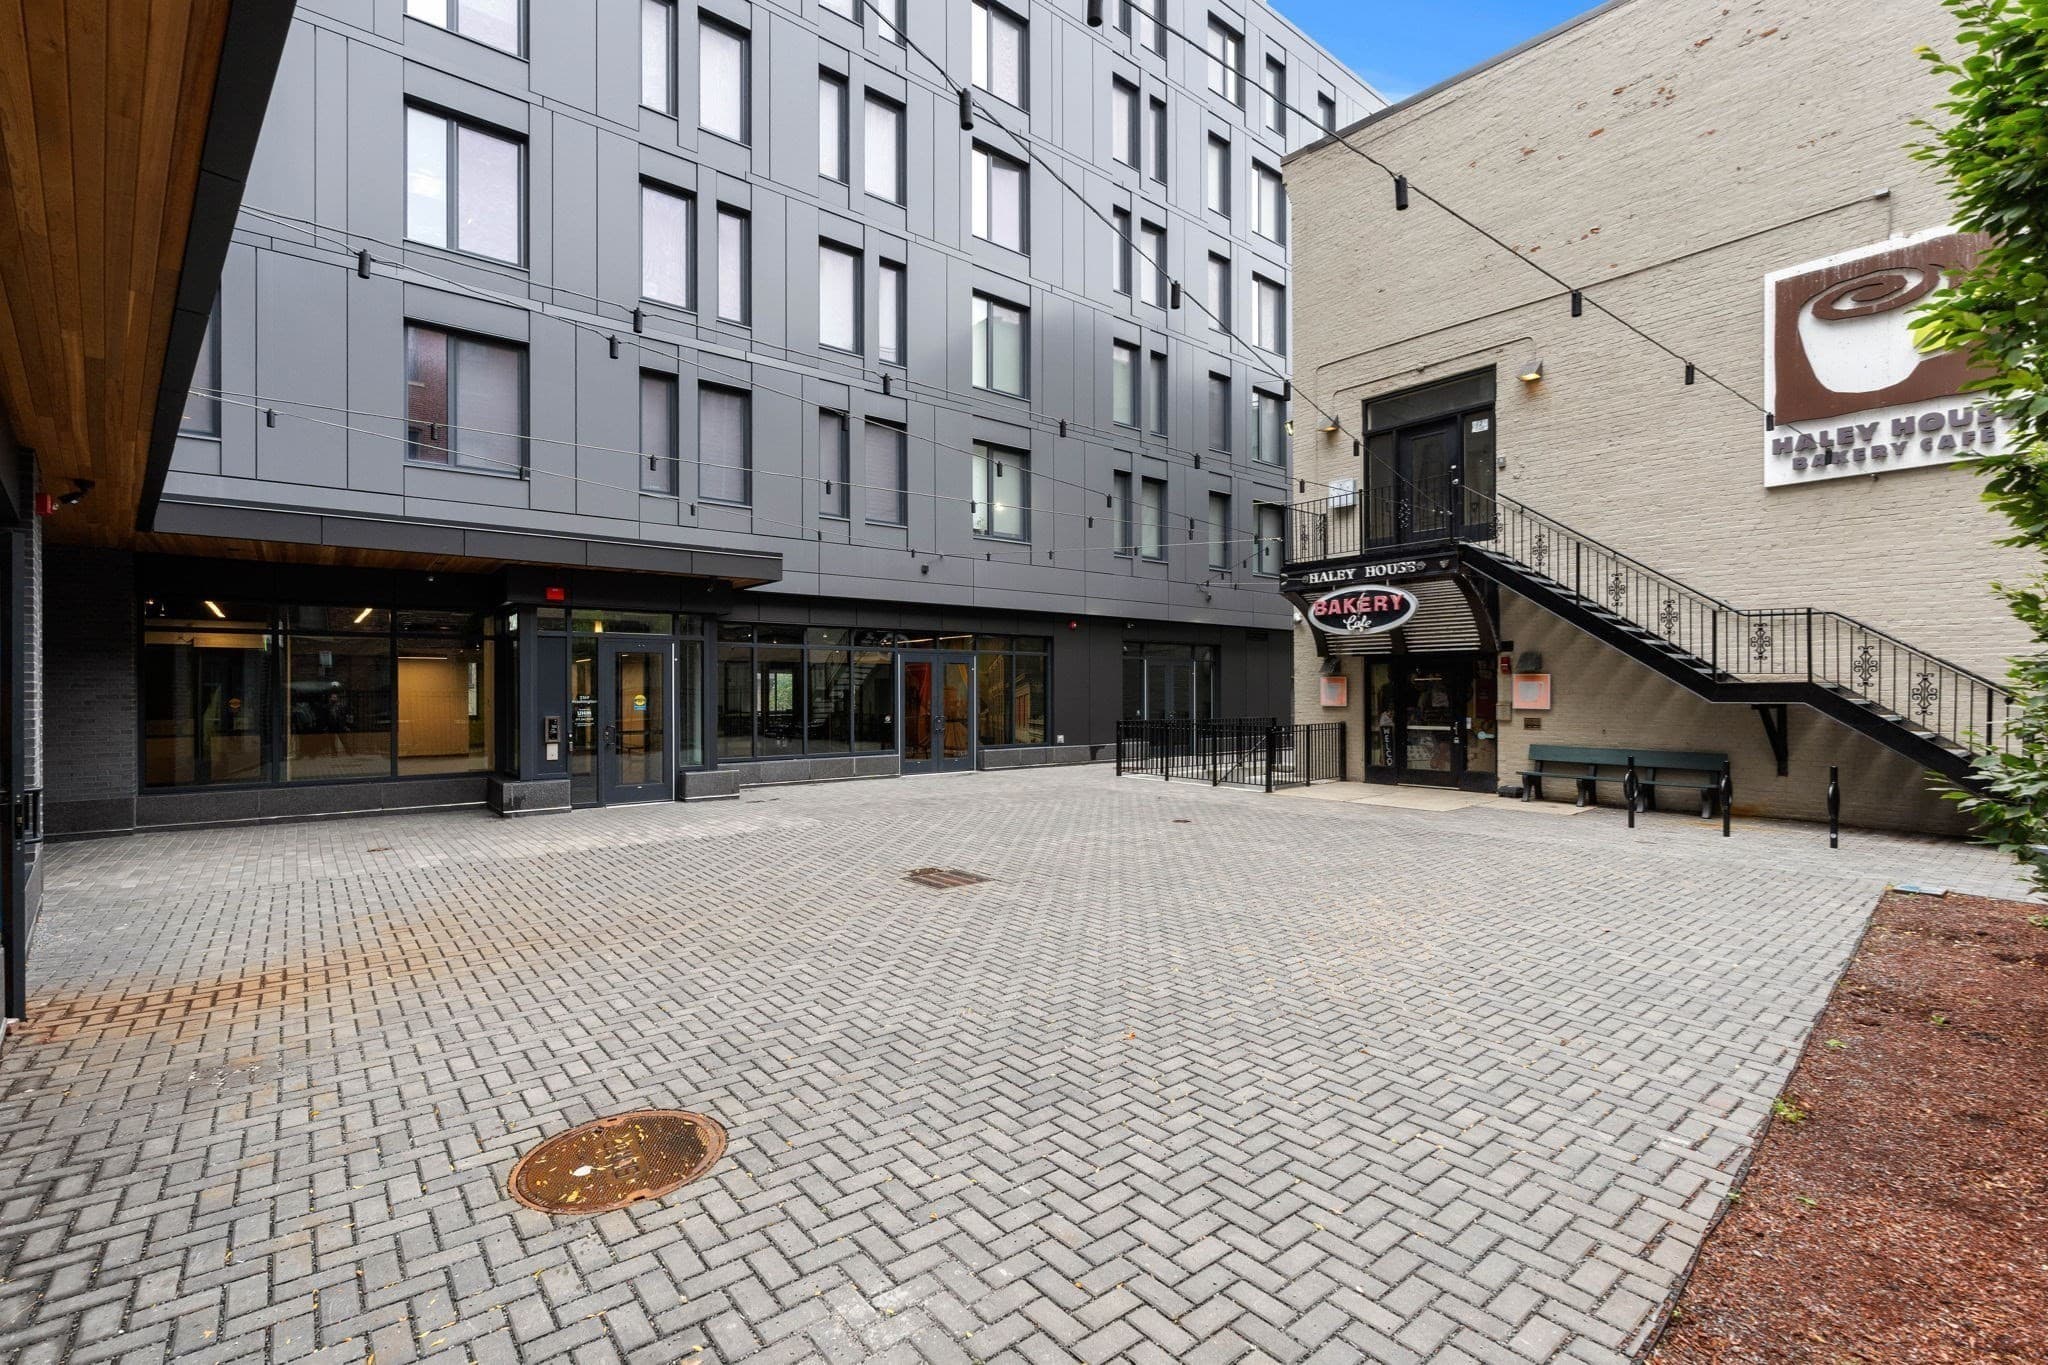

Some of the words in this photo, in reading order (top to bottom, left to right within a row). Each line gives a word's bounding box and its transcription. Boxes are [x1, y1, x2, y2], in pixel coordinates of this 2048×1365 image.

[1772, 421, 1880, 456] HALEY
[1891, 405, 2017, 437] HOUS
[1792, 440, 1908, 471] BAKERY
[1309, 567, 1357, 584] HALEY
[1313, 594, 1404, 616] BAKERY
